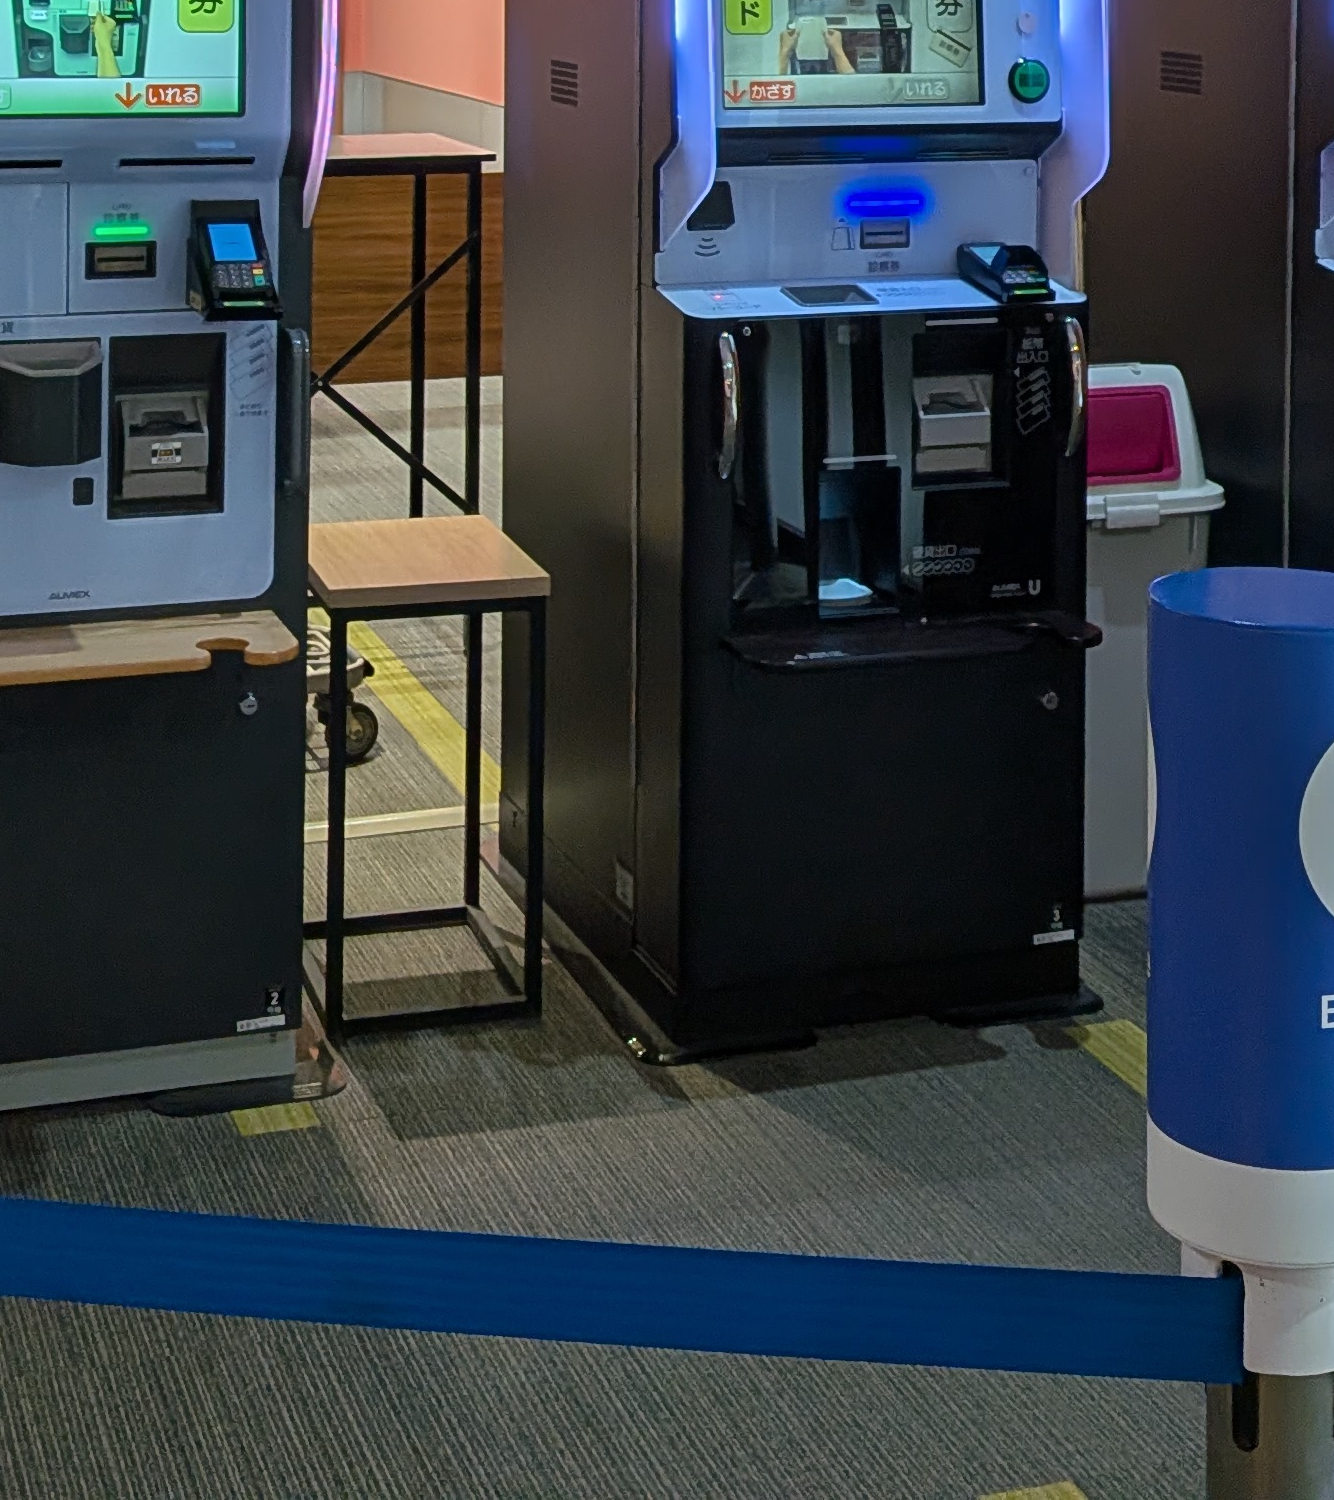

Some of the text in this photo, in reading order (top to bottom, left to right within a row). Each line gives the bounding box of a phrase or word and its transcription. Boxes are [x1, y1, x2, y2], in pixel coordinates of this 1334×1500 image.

[147, 85, 199, 104] いれる
[751, 82, 794, 100] かざす
[905, 79, 948, 97] いれる
